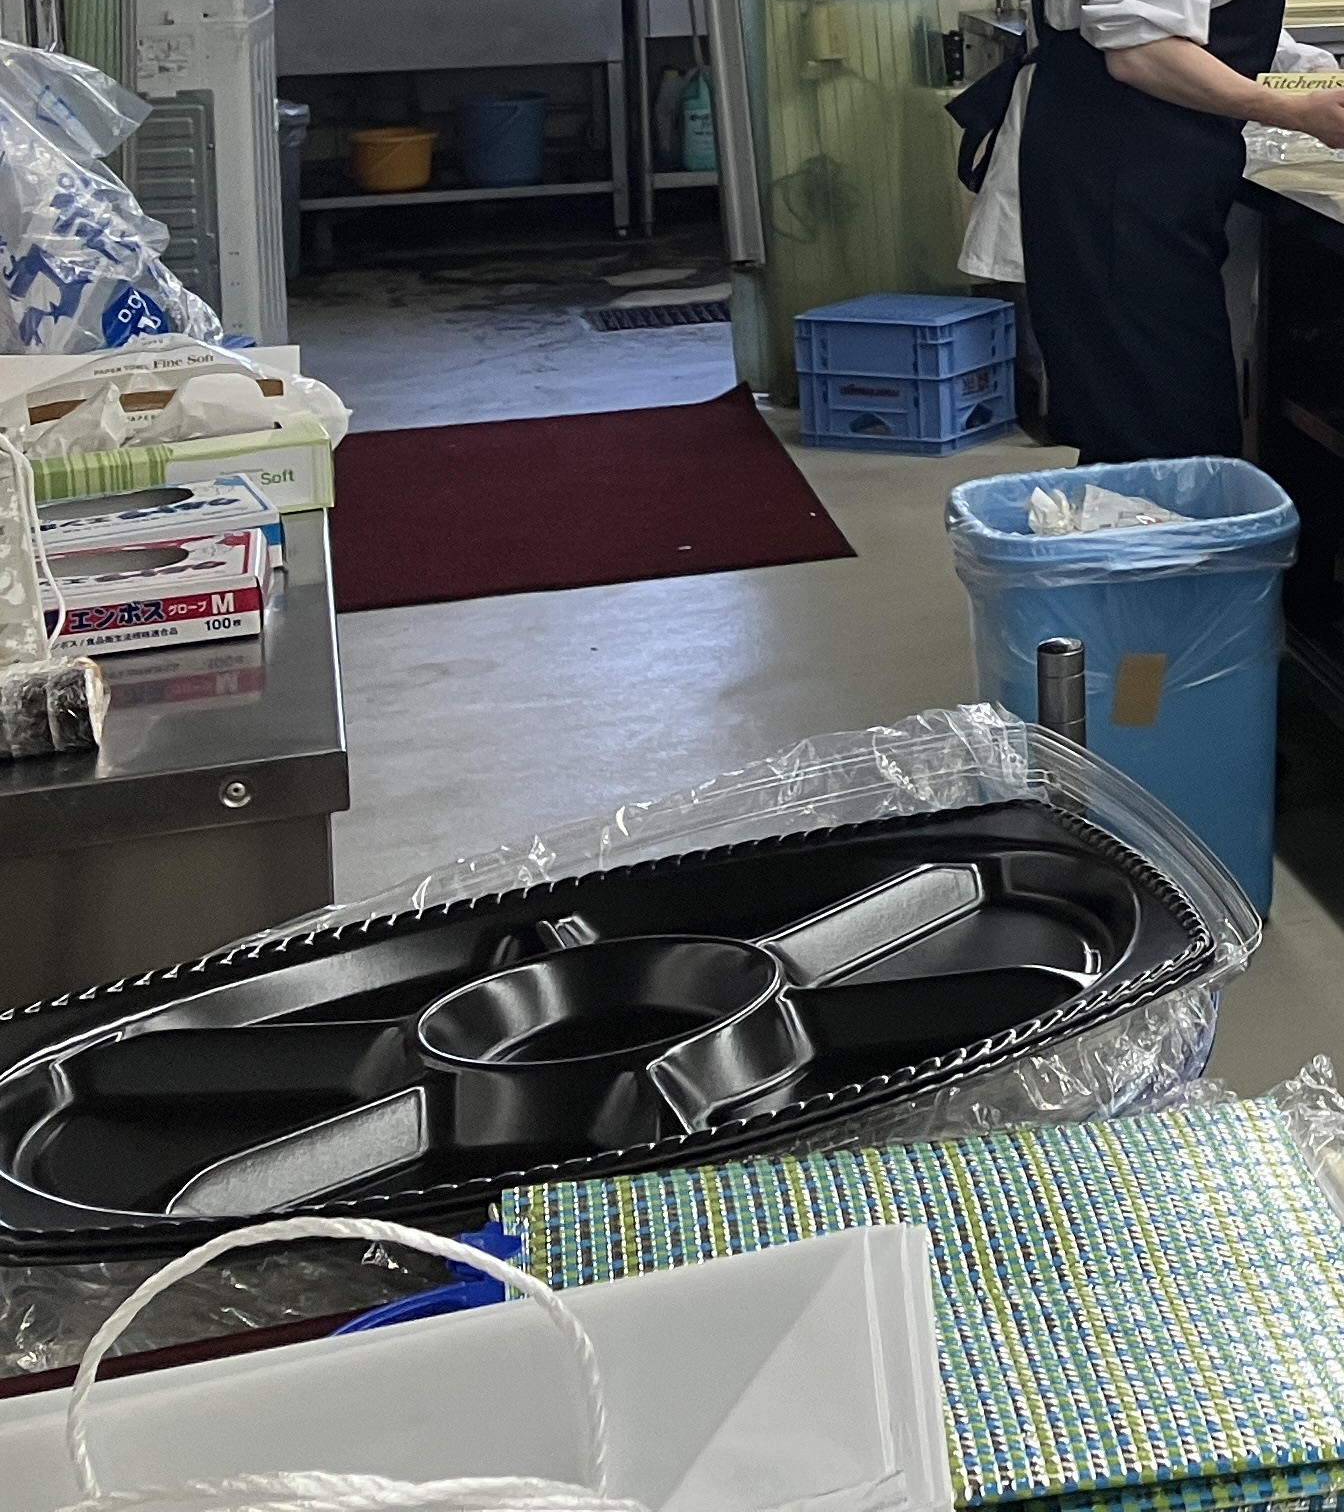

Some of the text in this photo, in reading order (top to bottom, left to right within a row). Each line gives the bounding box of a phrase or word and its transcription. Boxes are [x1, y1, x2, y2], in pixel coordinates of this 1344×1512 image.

[153, 359, 184, 370] Fine
[260, 468, 295, 486] Soft
[168, 599, 208, 616] グローブ
[211, 592, 236, 615] M
[203, 617, 242, 631] 100枚
